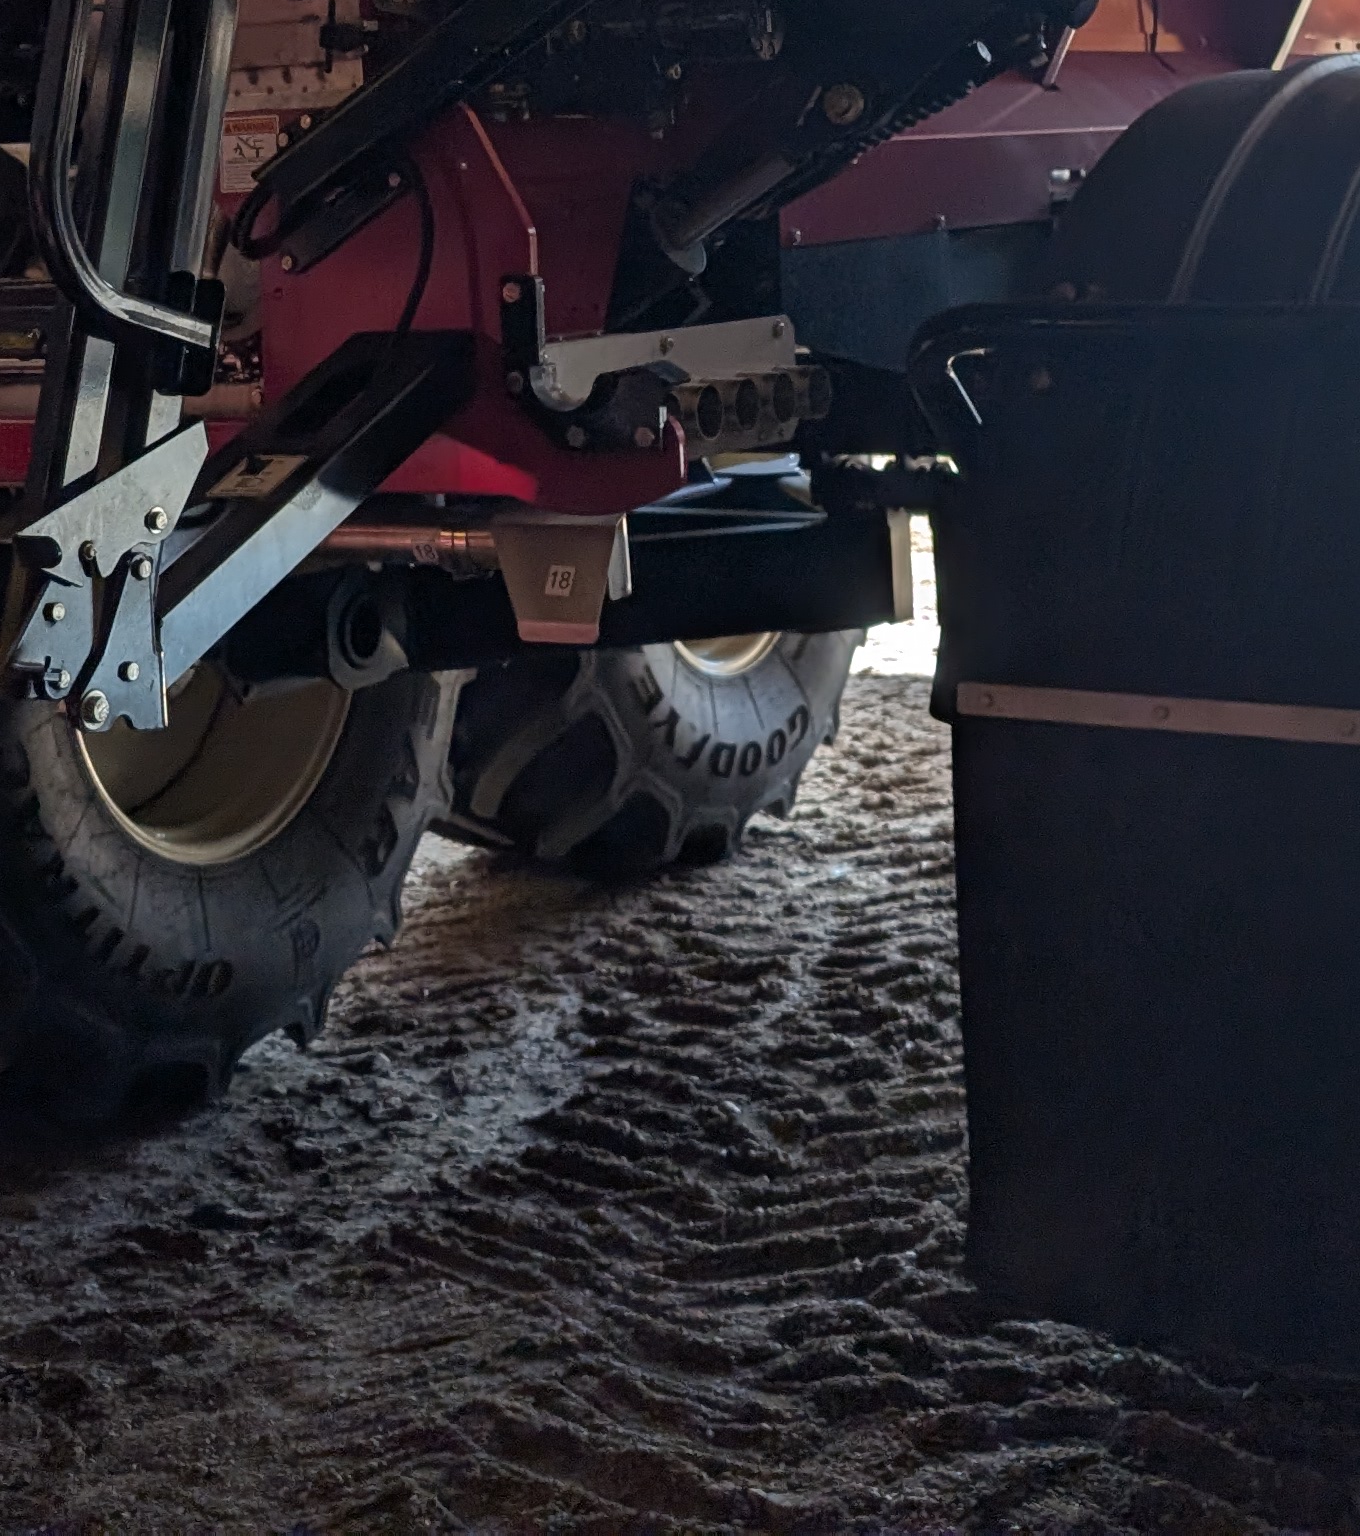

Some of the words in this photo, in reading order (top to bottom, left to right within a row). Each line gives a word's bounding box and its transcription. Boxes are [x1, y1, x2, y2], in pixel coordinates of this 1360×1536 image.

[415, 544, 436, 560] 18
[551, 570, 571, 589] 18
[629, 664, 809, 778] GOODYE
